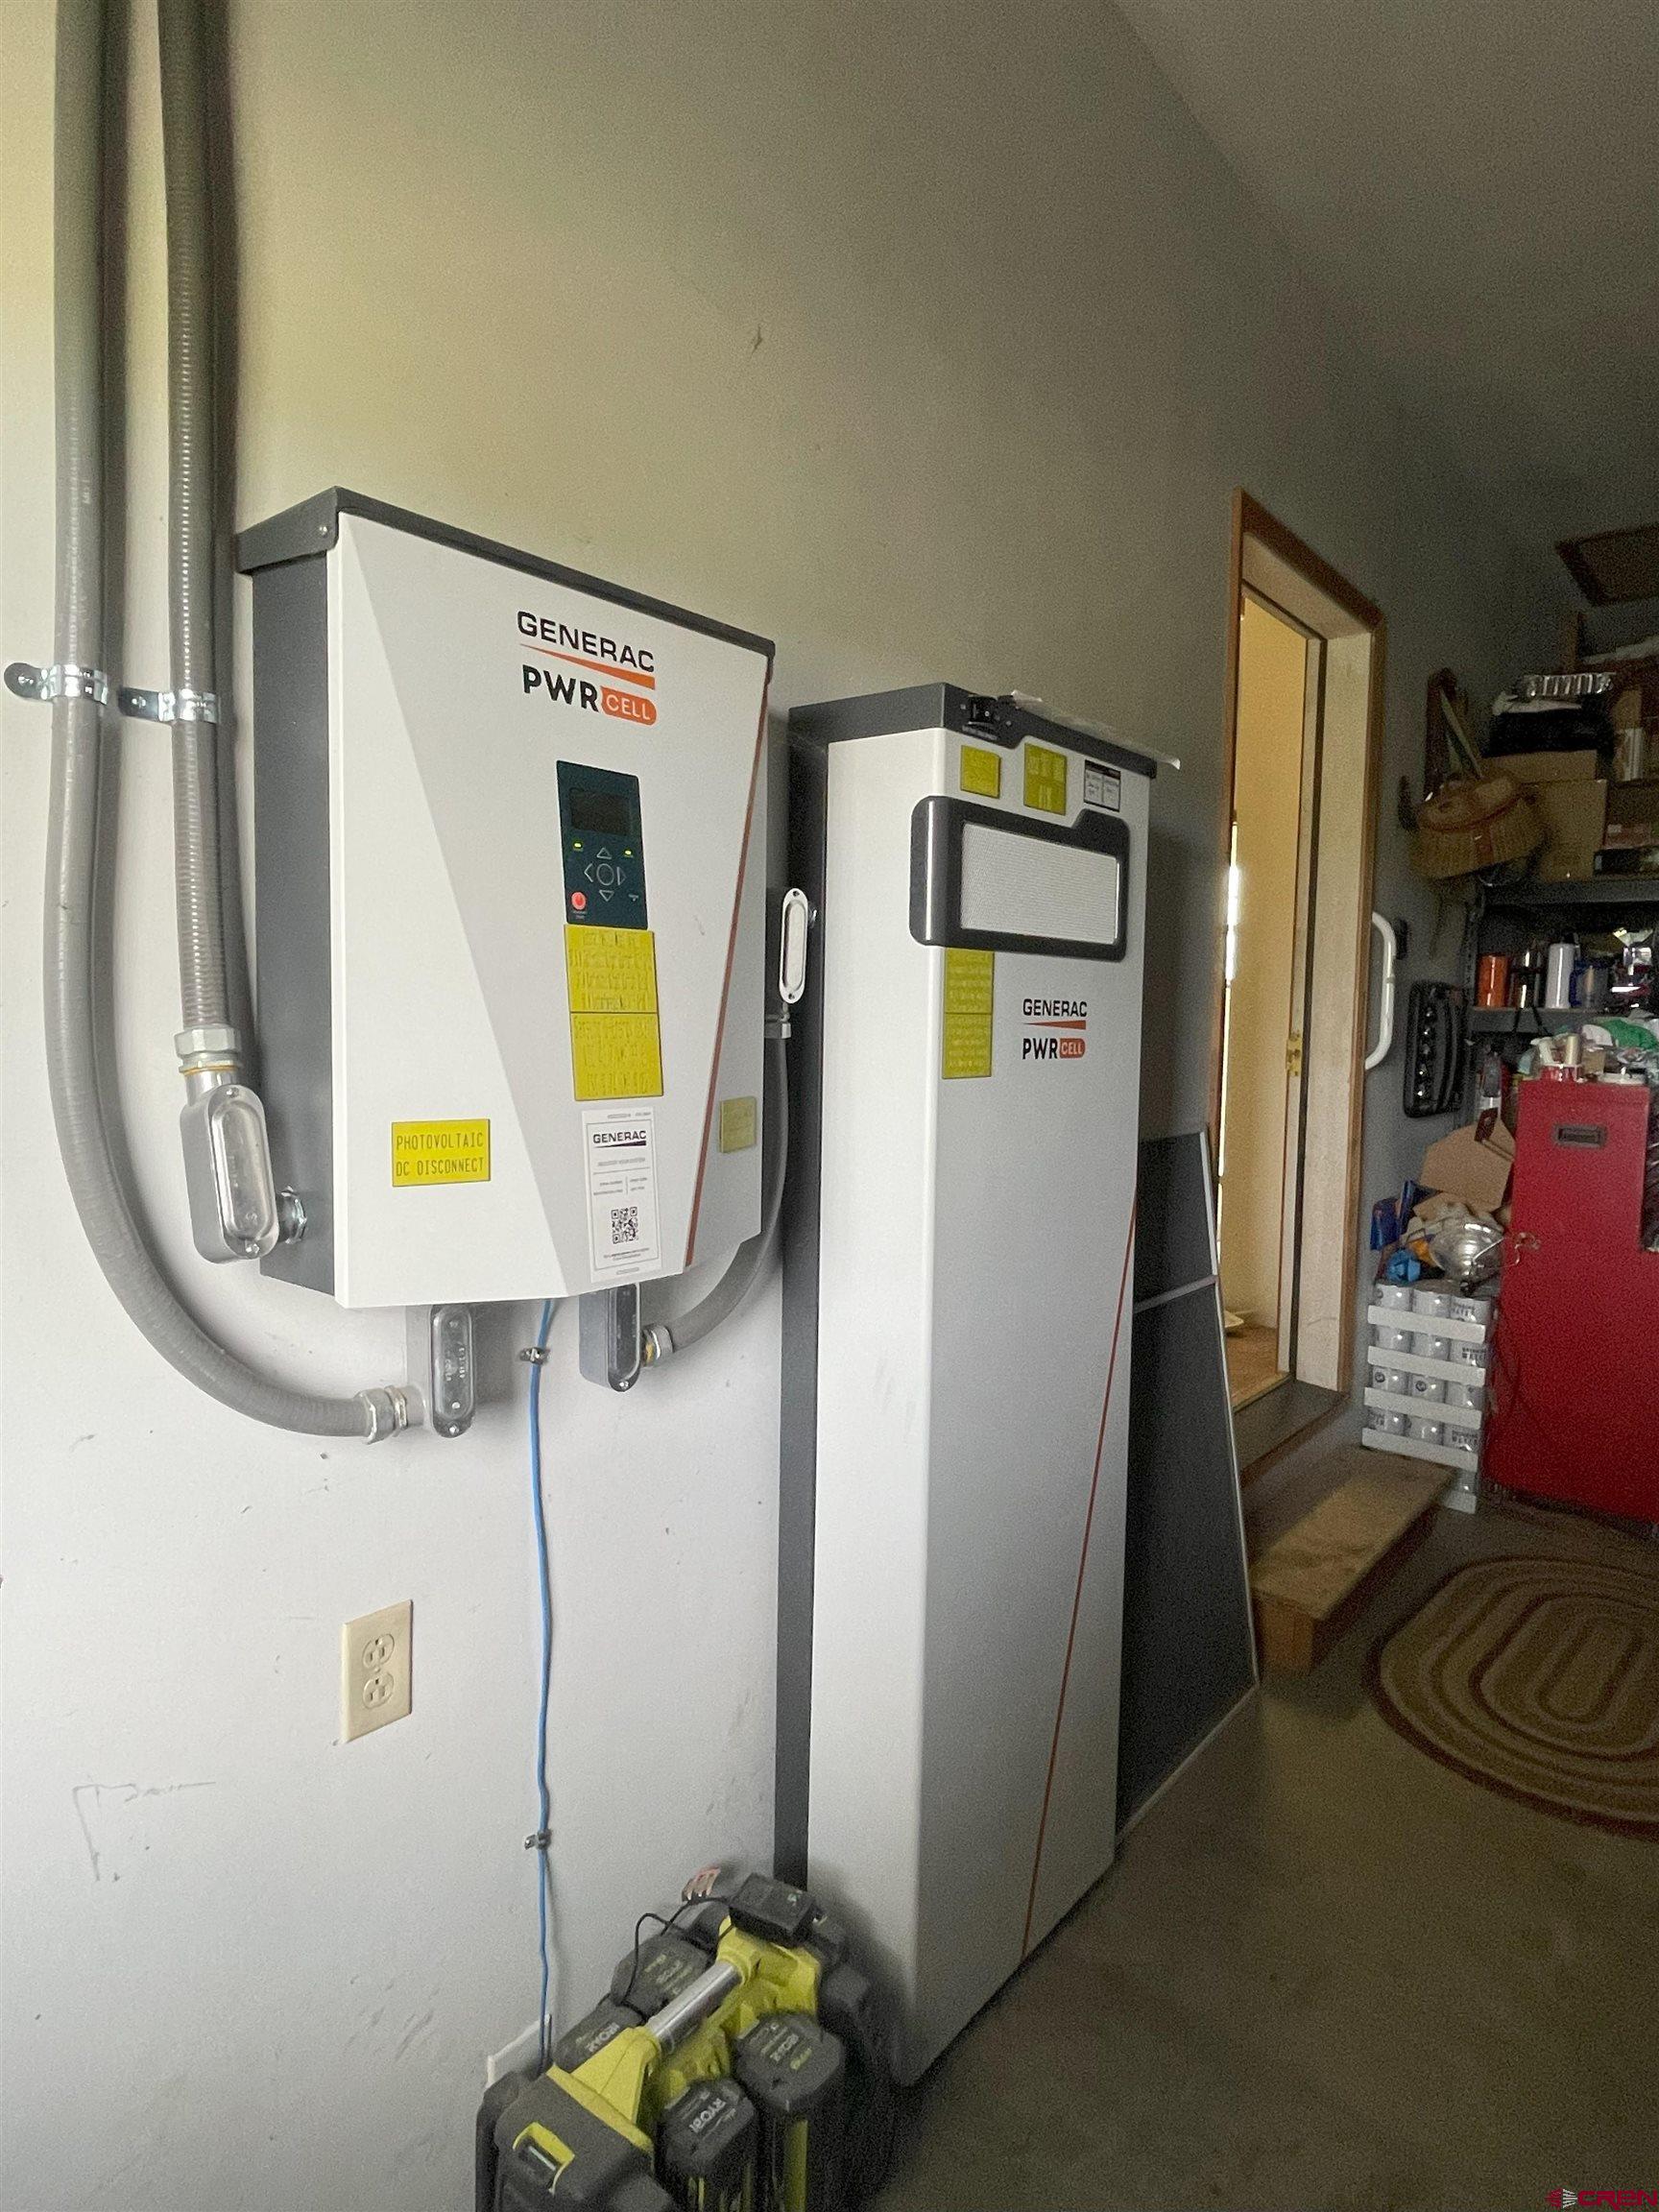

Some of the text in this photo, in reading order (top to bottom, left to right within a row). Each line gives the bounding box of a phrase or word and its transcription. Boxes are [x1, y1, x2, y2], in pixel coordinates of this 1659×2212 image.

[517, 611, 655, 672] GENERAC
[522, 664, 651, 720] PWR CELL
[1022, 998, 1088, 1018] GENERAC
[1022, 1038, 1084, 1060] PWR CELL
[396, 1132, 484, 1151] PHOTOVOLTAIC
[592, 1130, 647, 1144] GENERAC
[396, 1157, 484, 1177] DC DISCONNECT
[688, 2097, 727, 2133] RYOBI
